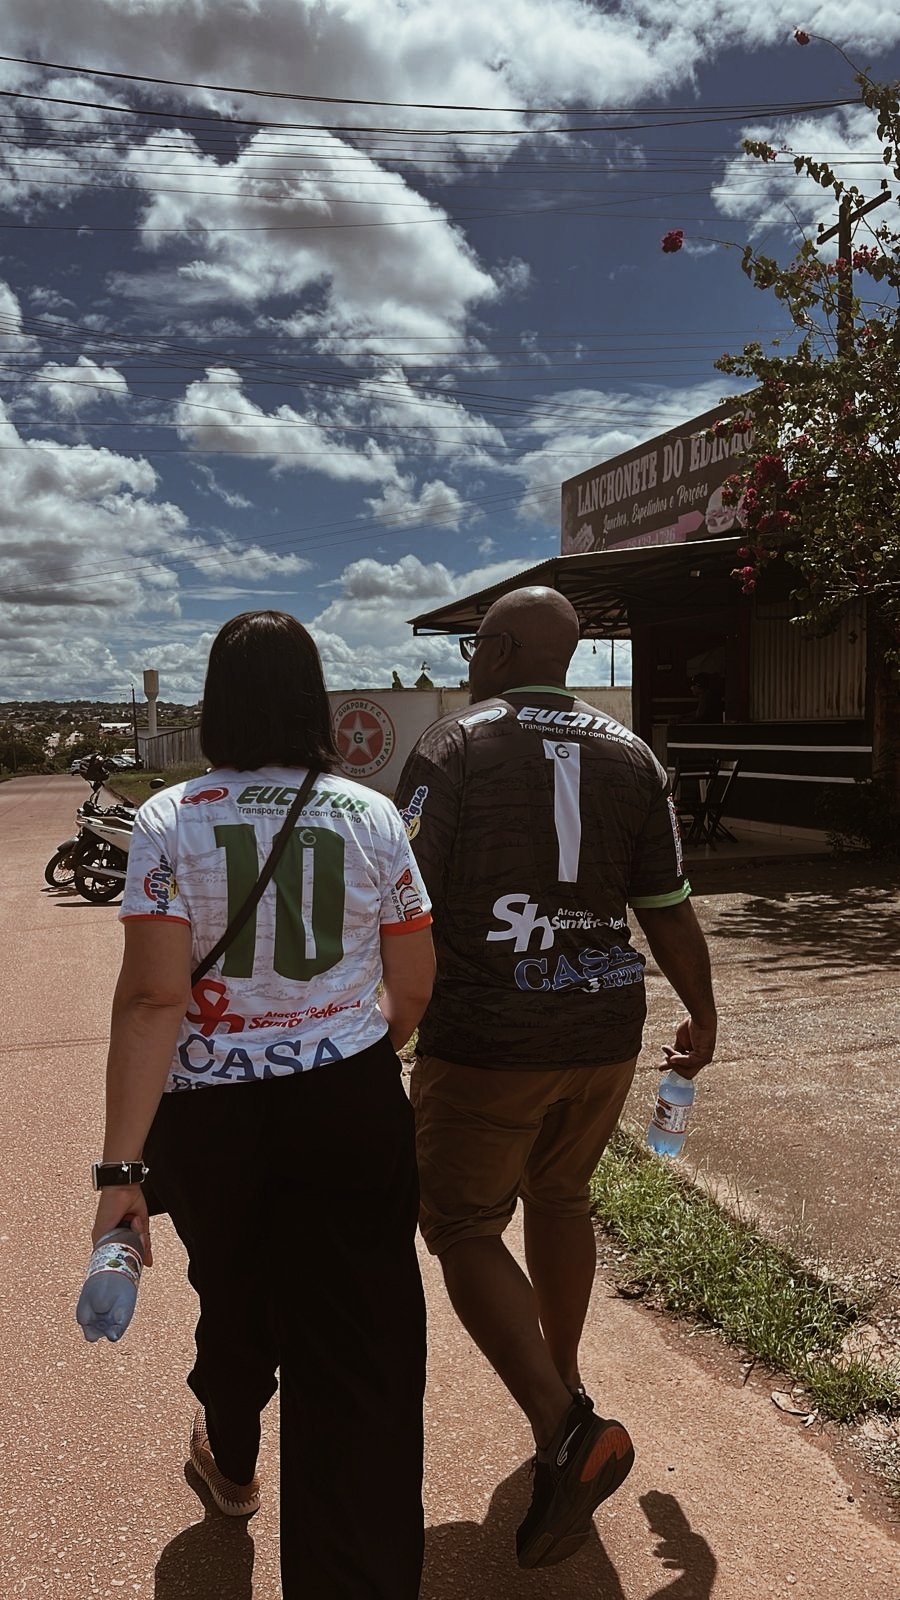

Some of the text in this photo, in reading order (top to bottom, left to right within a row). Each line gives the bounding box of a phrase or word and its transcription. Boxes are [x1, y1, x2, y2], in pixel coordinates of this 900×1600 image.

[577, 451, 657, 517] LANCHONETE
[662, 439, 684, 483] DO
[353, 731, 364, 744] G
[516, 706, 635, 742] EUCATUR
[519, 722, 564, 735] Transporte
[566, 727, 587, 736] Feito
[588, 731, 606, 739] com
[375, 730, 392, 767] BRASIL
[237, 806, 284, 816] Transporte
[543, 739, 581, 883] 1
[213, 823, 345, 982] 10
[177, 1033, 344, 1081] CASA
